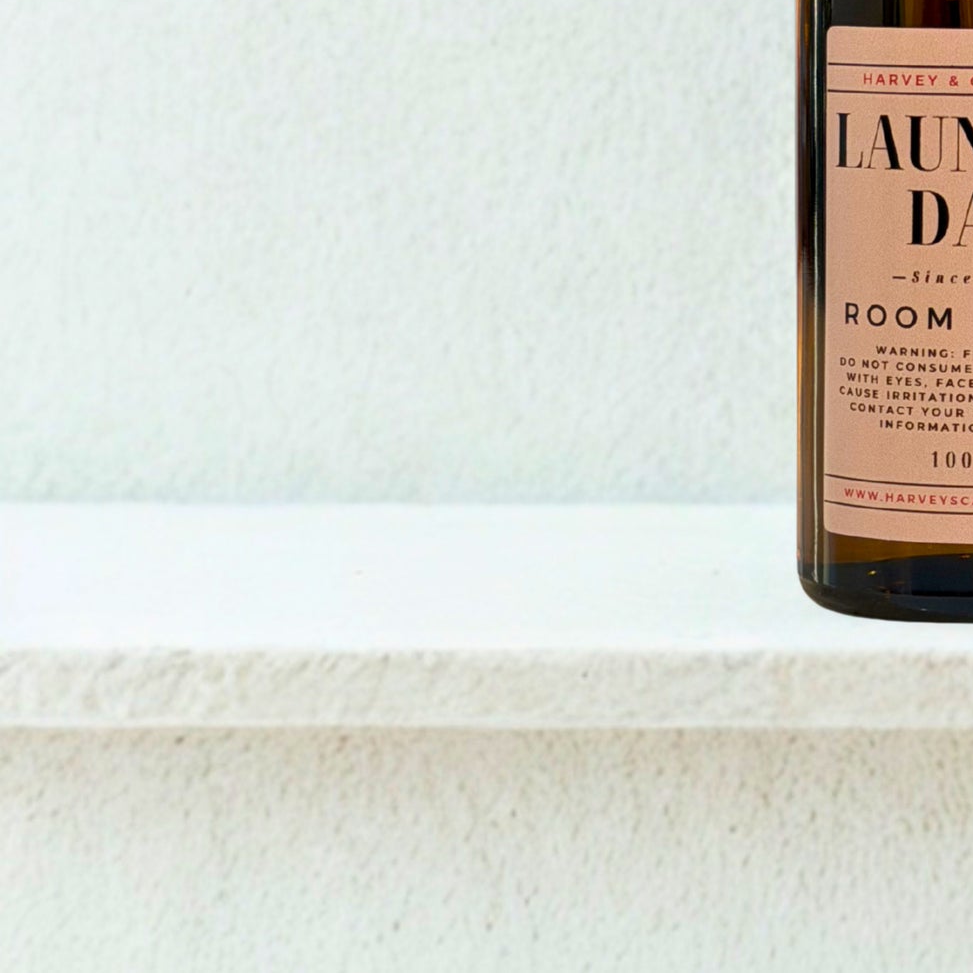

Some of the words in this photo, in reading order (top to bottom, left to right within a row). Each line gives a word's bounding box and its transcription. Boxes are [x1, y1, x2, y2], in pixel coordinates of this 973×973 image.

[863, 73, 938, 87] HARVEY
[949, 76, 960, 87] &
[844, 302, 953, 330] ROOM
[876, 345, 955, 359] WARNING:
[840, 357, 856, 367] DO
[862, 359, 889, 370] NOT
[847, 372, 879, 385] WITH
[839, 386, 879, 399] CAUSE
[850, 402, 914, 416] CONTACT
[921, 407, 965, 418] YOUR
